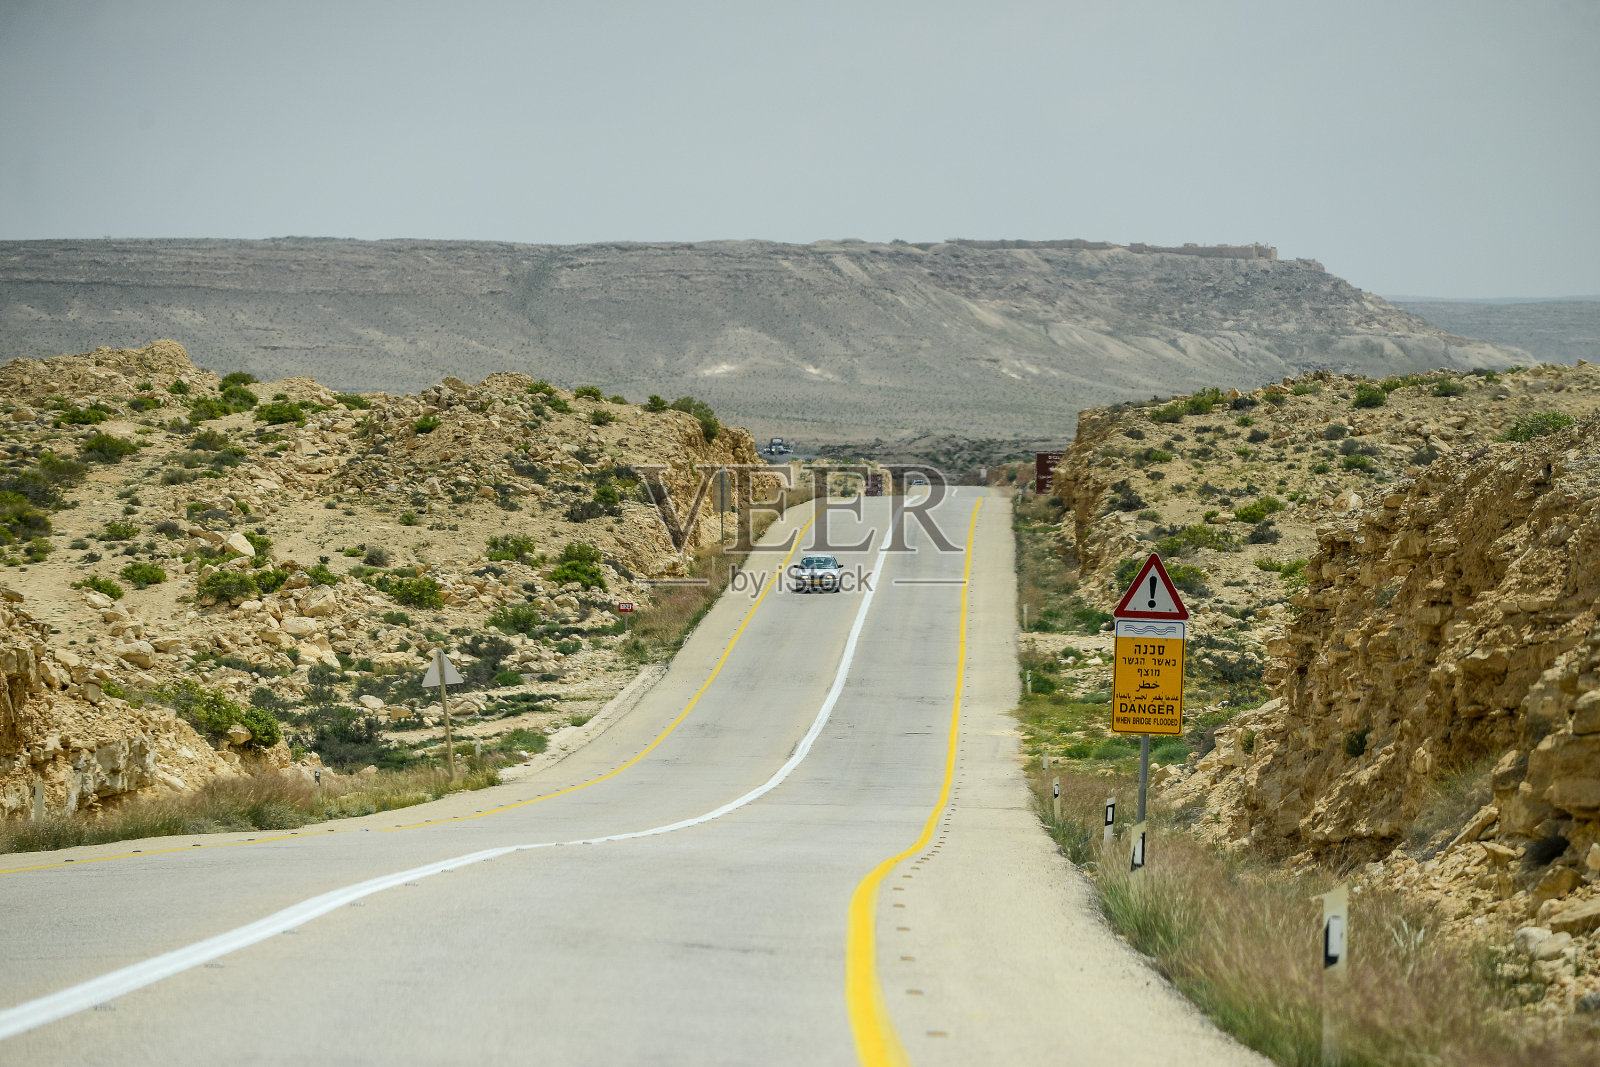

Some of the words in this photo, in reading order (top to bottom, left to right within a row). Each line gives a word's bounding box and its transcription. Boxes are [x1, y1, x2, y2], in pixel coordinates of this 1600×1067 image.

[1134, 644, 1165, 656] סכנה
[1122, 656, 1146, 665] הגשר
[1151, 658, 1177, 667] כאשר
[1137, 668, 1160, 677] מוצף
[1135, 680, 1160, 692] خطر
[1119, 702, 1175, 715] DANGER
[1115, 716, 1131, 724] WHEN
[1132, 716, 1152, 725] BRIDGE
[1153, 718, 1179, 726] FLOODED
